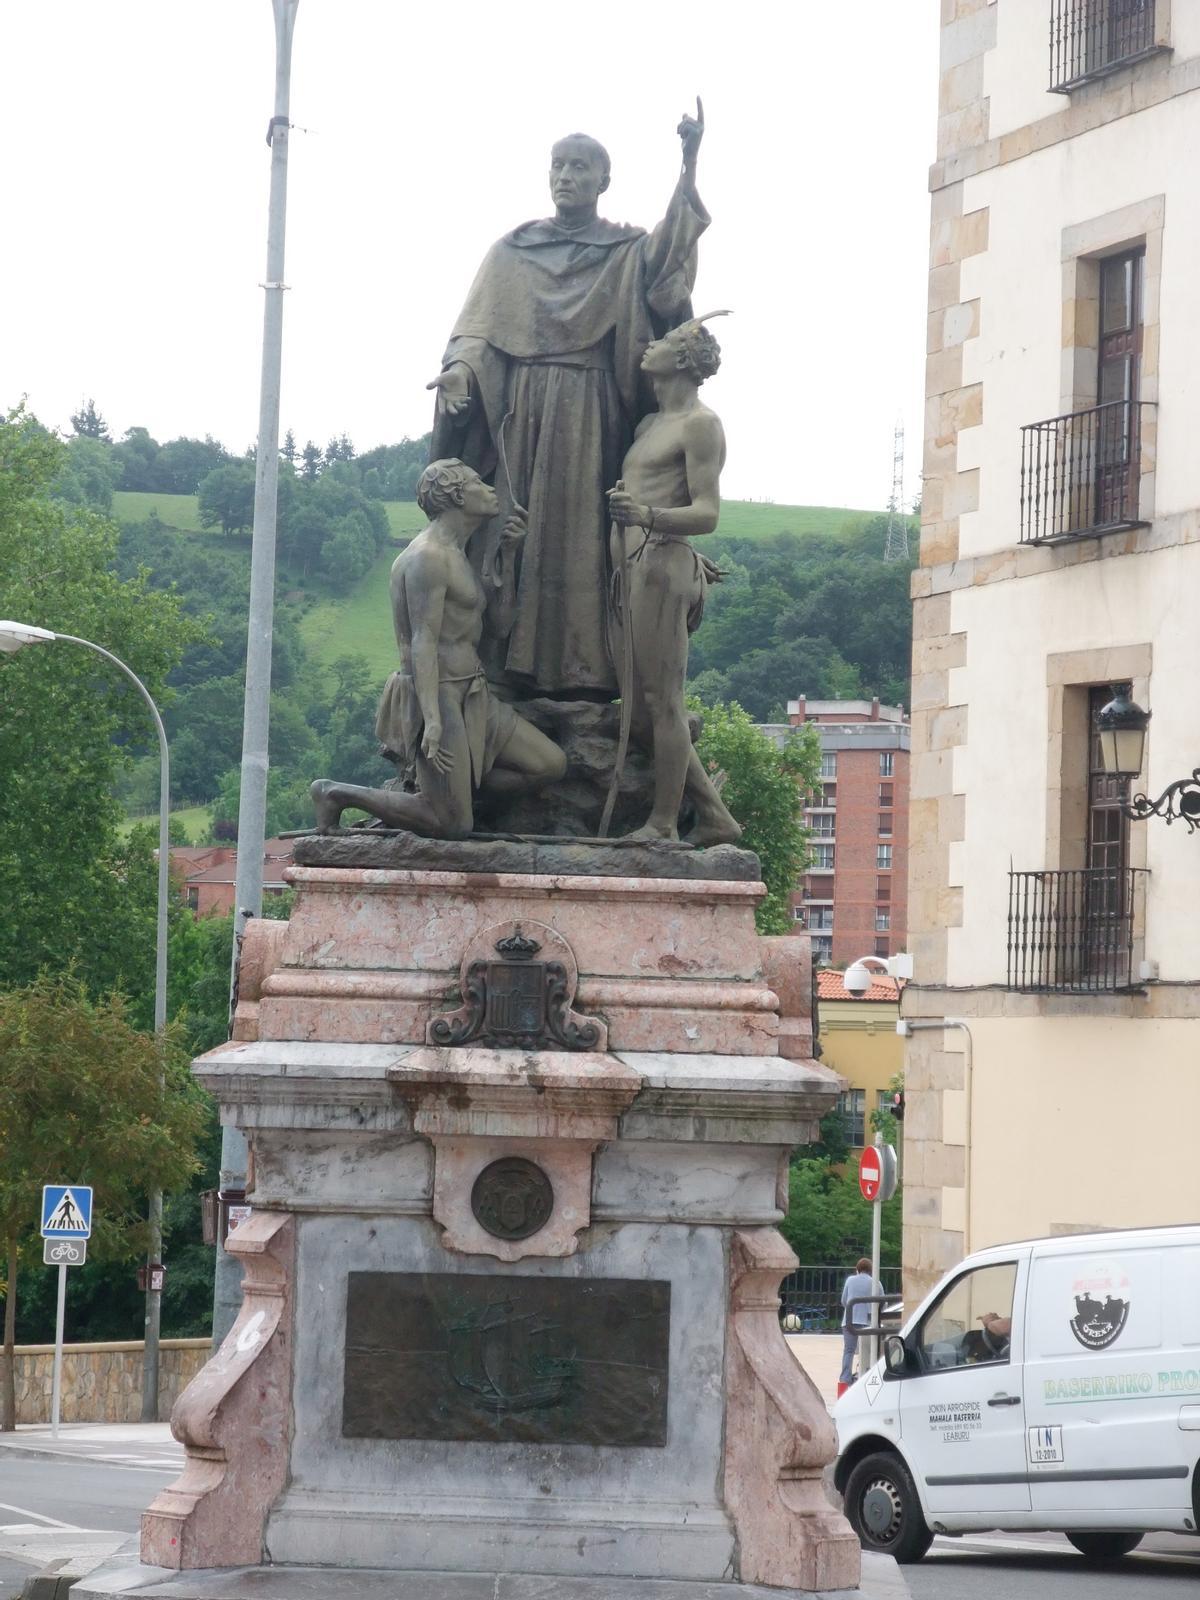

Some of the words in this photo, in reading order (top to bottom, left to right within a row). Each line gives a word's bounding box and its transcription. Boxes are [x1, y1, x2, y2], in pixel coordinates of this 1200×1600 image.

[1043, 1372, 1153, 1399] BASERRIKO
[1157, 1369, 1200, 1393] PRO
[928, 1403, 946, 1414] JOKIN
[948, 1401, 981, 1413] ARROSPIDE
[929, 1414, 952, 1423] MAHALA
[953, 1412, 982, 1422] BASERRIA
[943, 1431, 970, 1441] LEABURU
[1035, 1449, 1057, 1460] 12-2010
